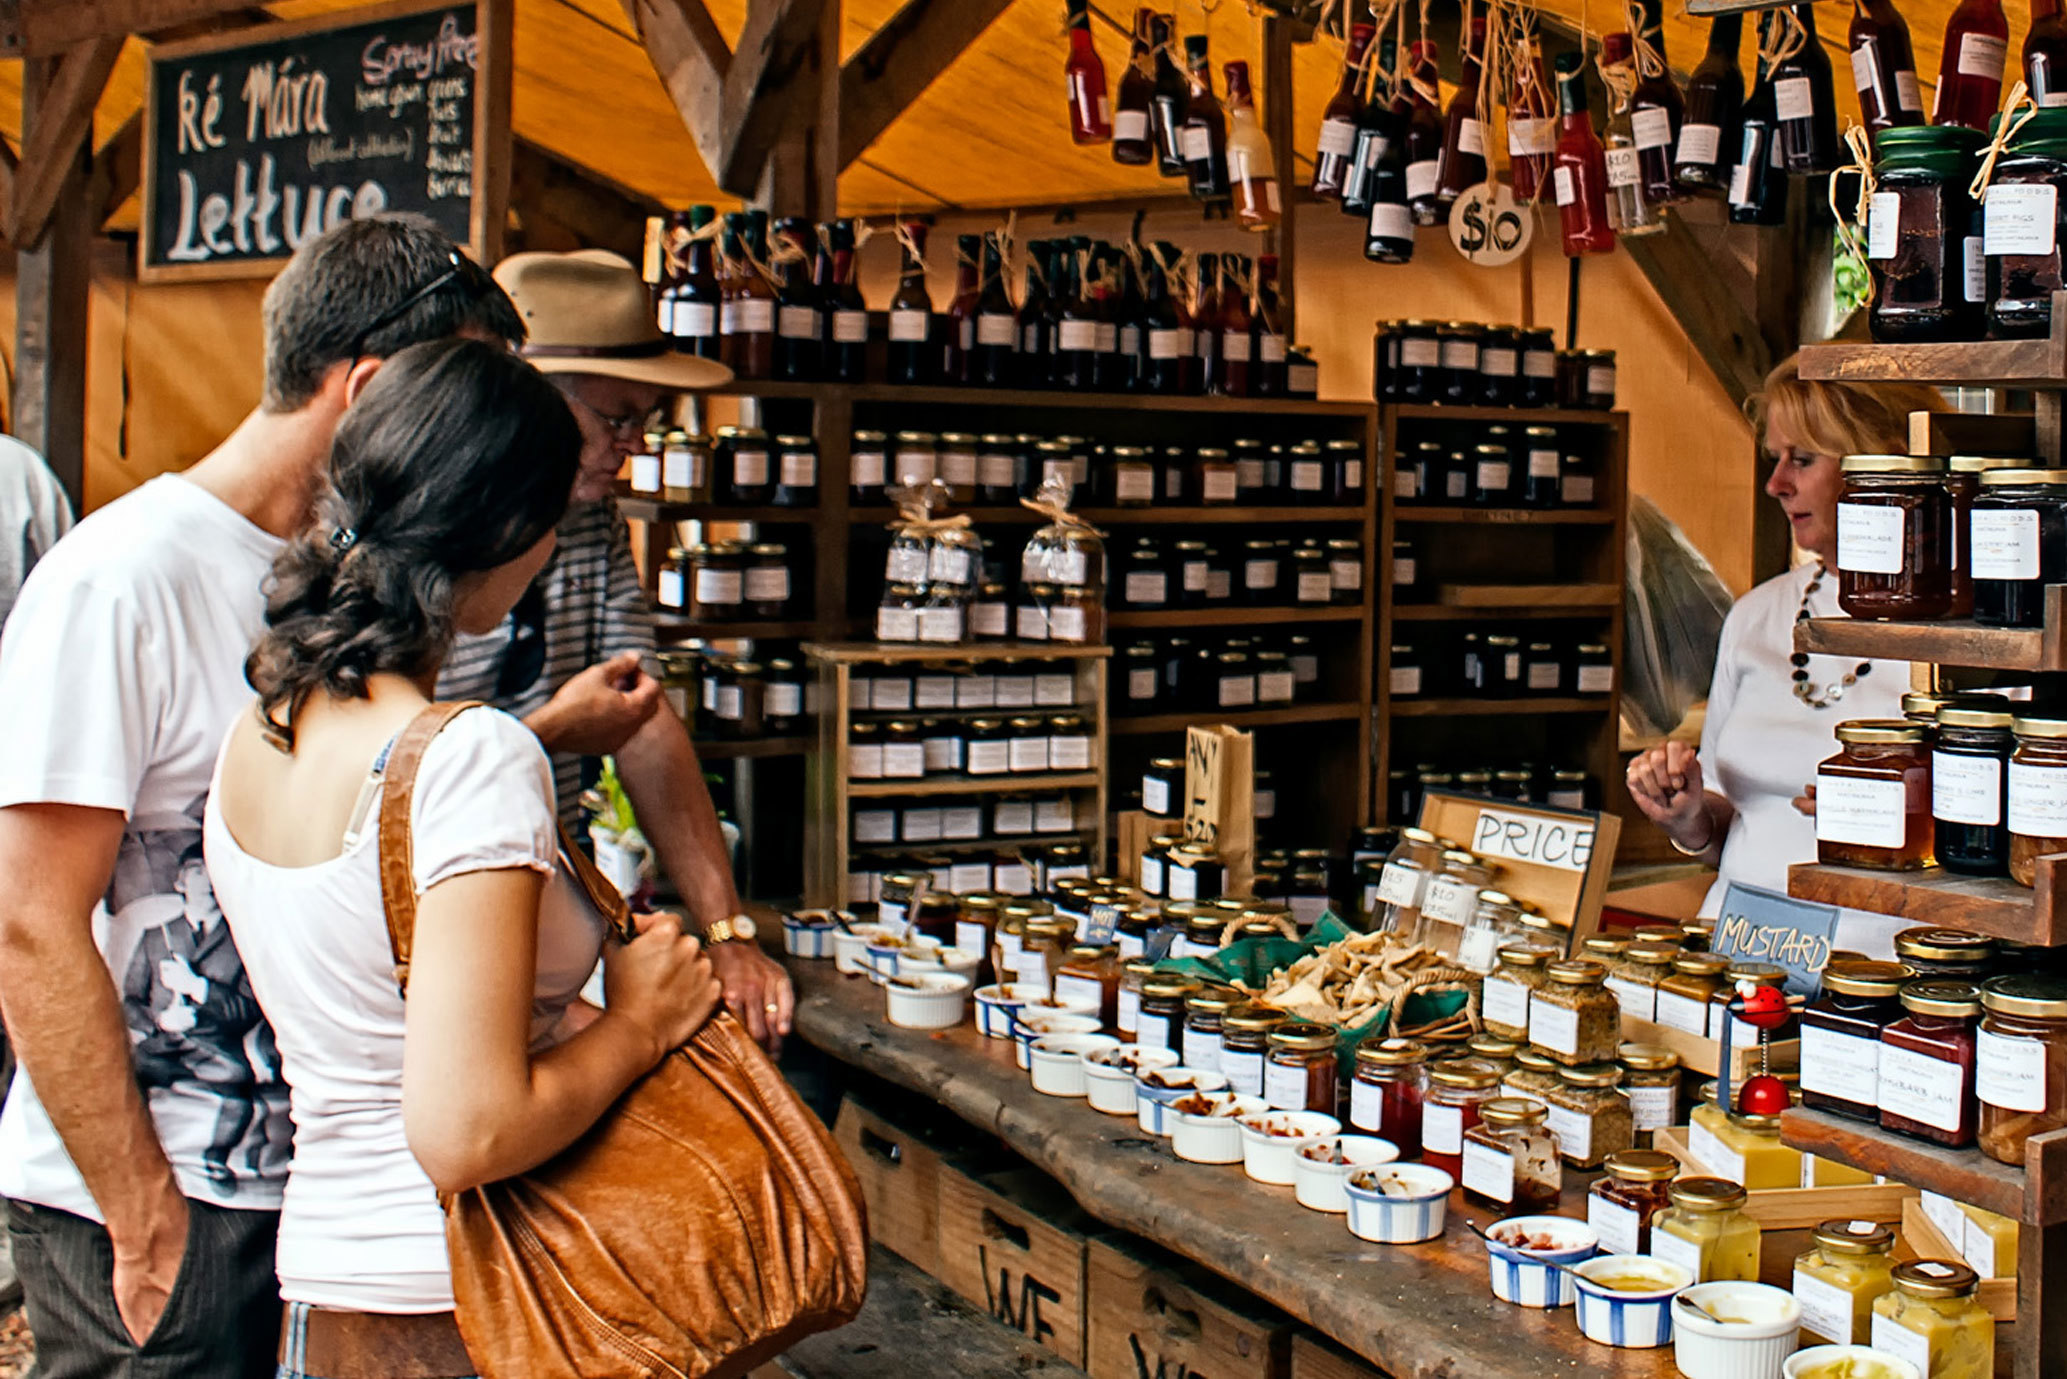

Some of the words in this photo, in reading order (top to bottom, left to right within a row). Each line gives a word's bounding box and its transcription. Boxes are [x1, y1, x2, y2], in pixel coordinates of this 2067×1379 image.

[1460, 196, 1522, 260] $10
[1480, 814, 1593, 866] PRICE
[1717, 914, 1830, 973] MUSTARD
